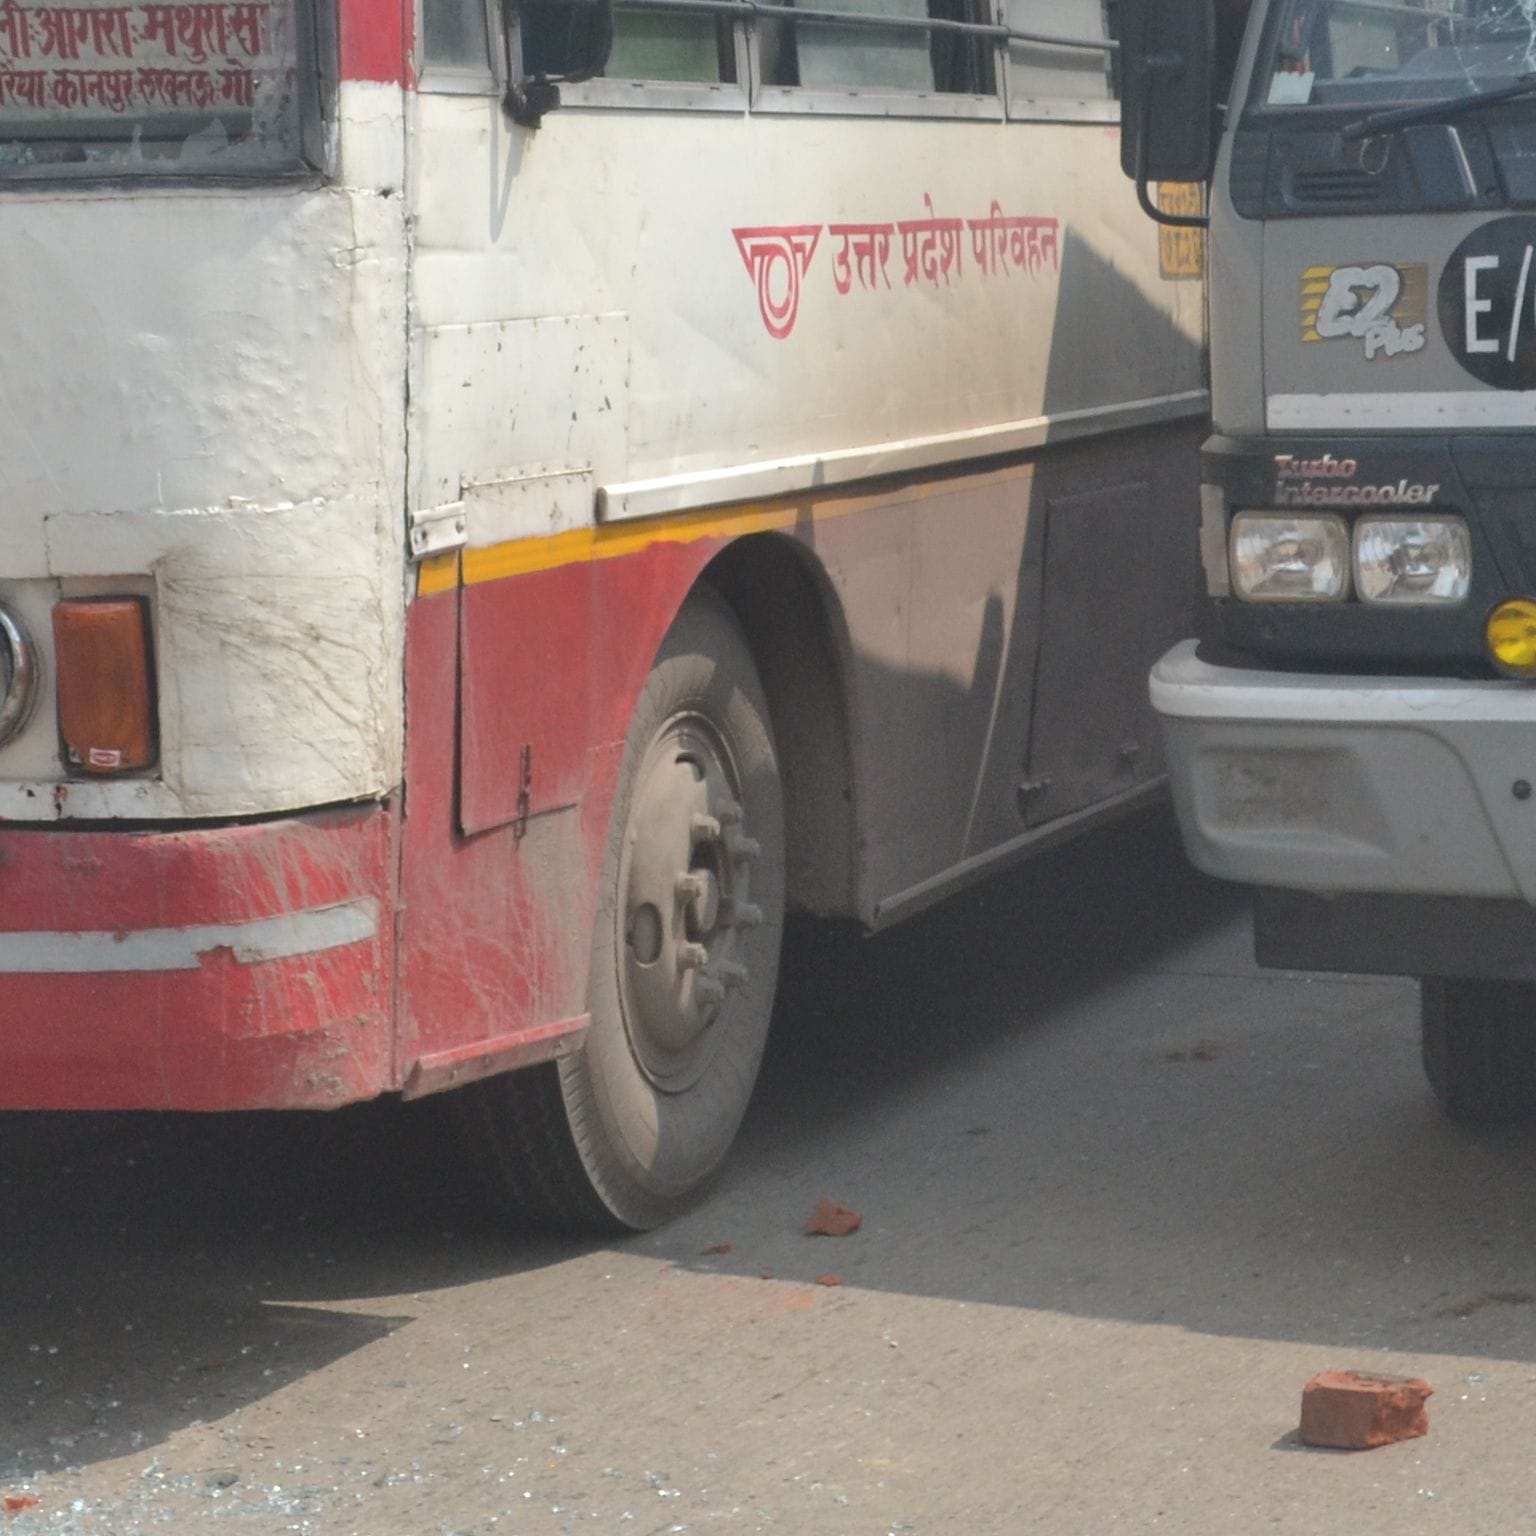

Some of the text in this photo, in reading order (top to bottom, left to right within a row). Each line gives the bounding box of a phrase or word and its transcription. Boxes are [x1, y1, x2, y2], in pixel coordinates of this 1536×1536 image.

[828, 192, 1060, 295] उत्तर प्रदेश परिवहन
[1274, 453, 1357, 479] Turbo
